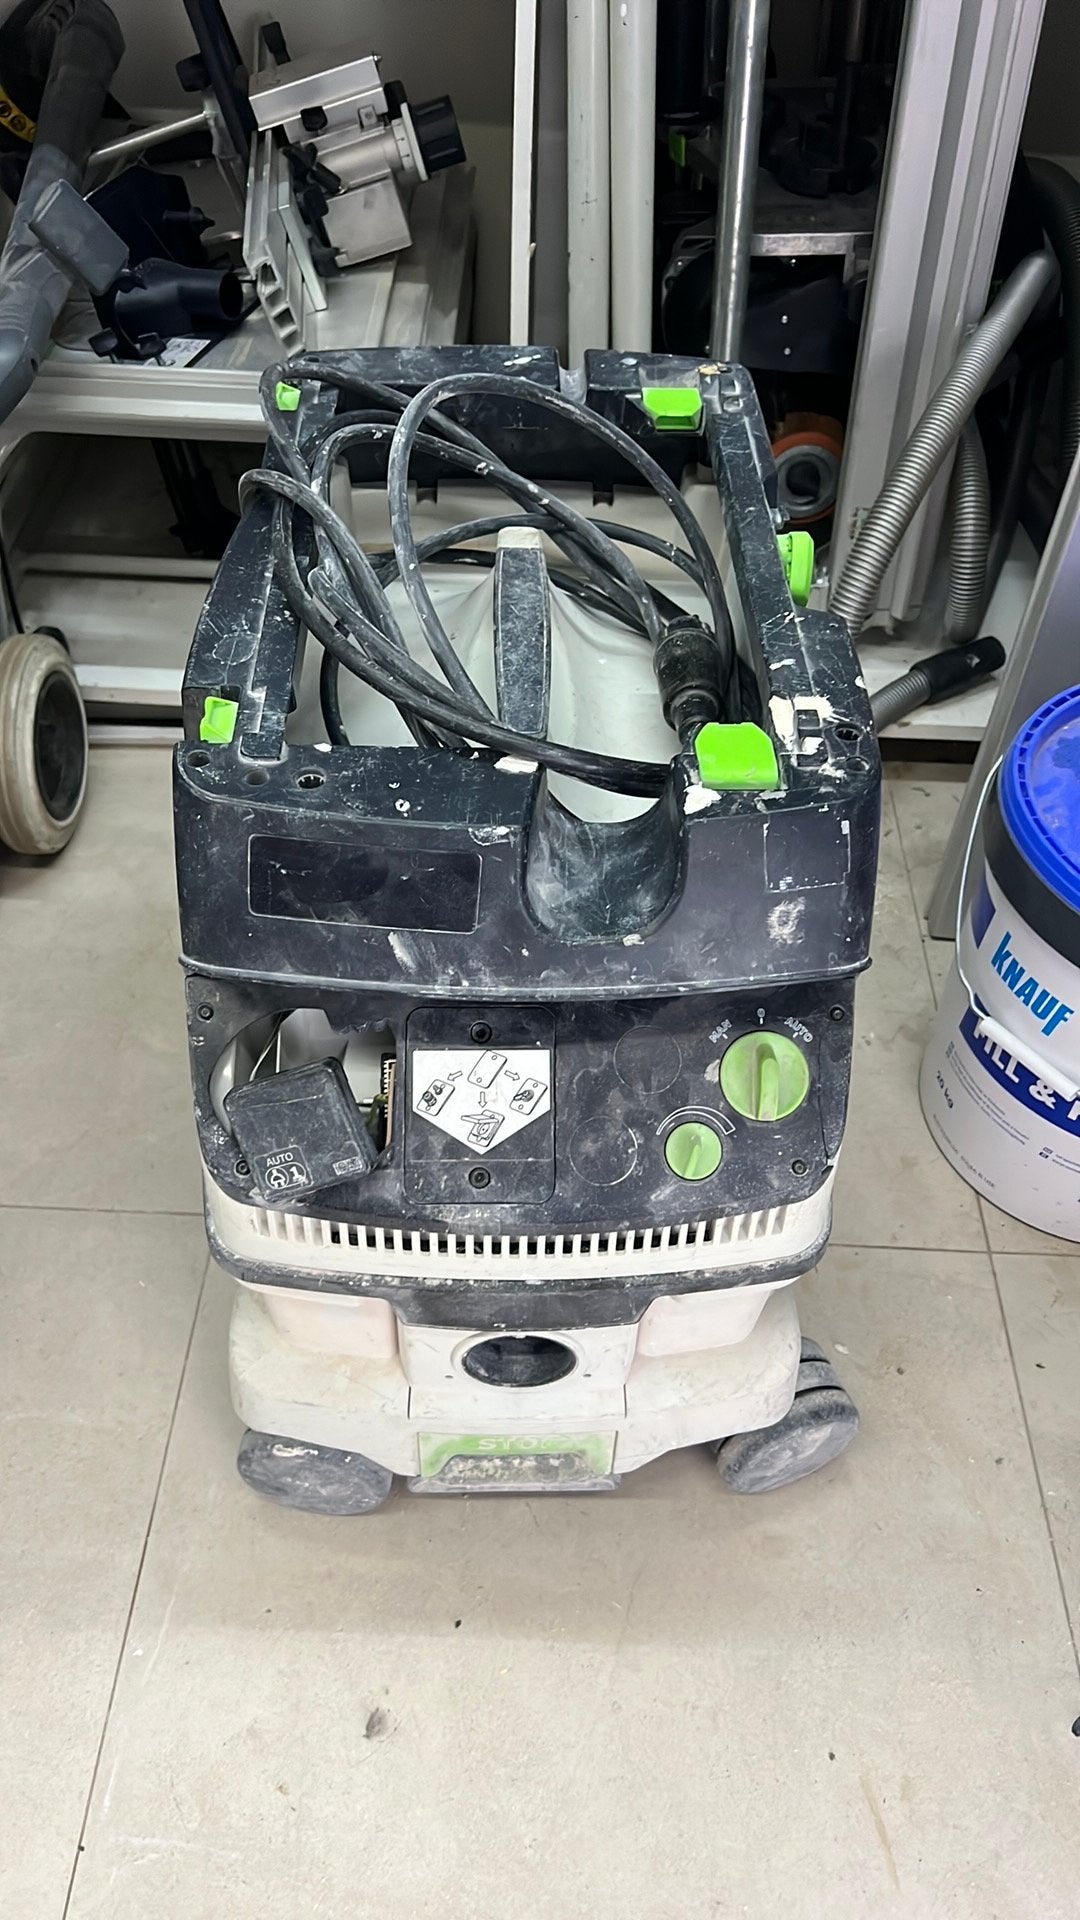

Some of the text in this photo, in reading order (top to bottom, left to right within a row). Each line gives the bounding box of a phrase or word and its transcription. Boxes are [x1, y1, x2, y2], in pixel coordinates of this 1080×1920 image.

[991, 931, 1075, 1036] KNAUF
[708, 1019, 733, 1043] MAN
[784, 1016, 814, 1043] AUTO
[1028, 1079, 1057, 1110] &
[266, 1152, 294, 1167] AUTO
